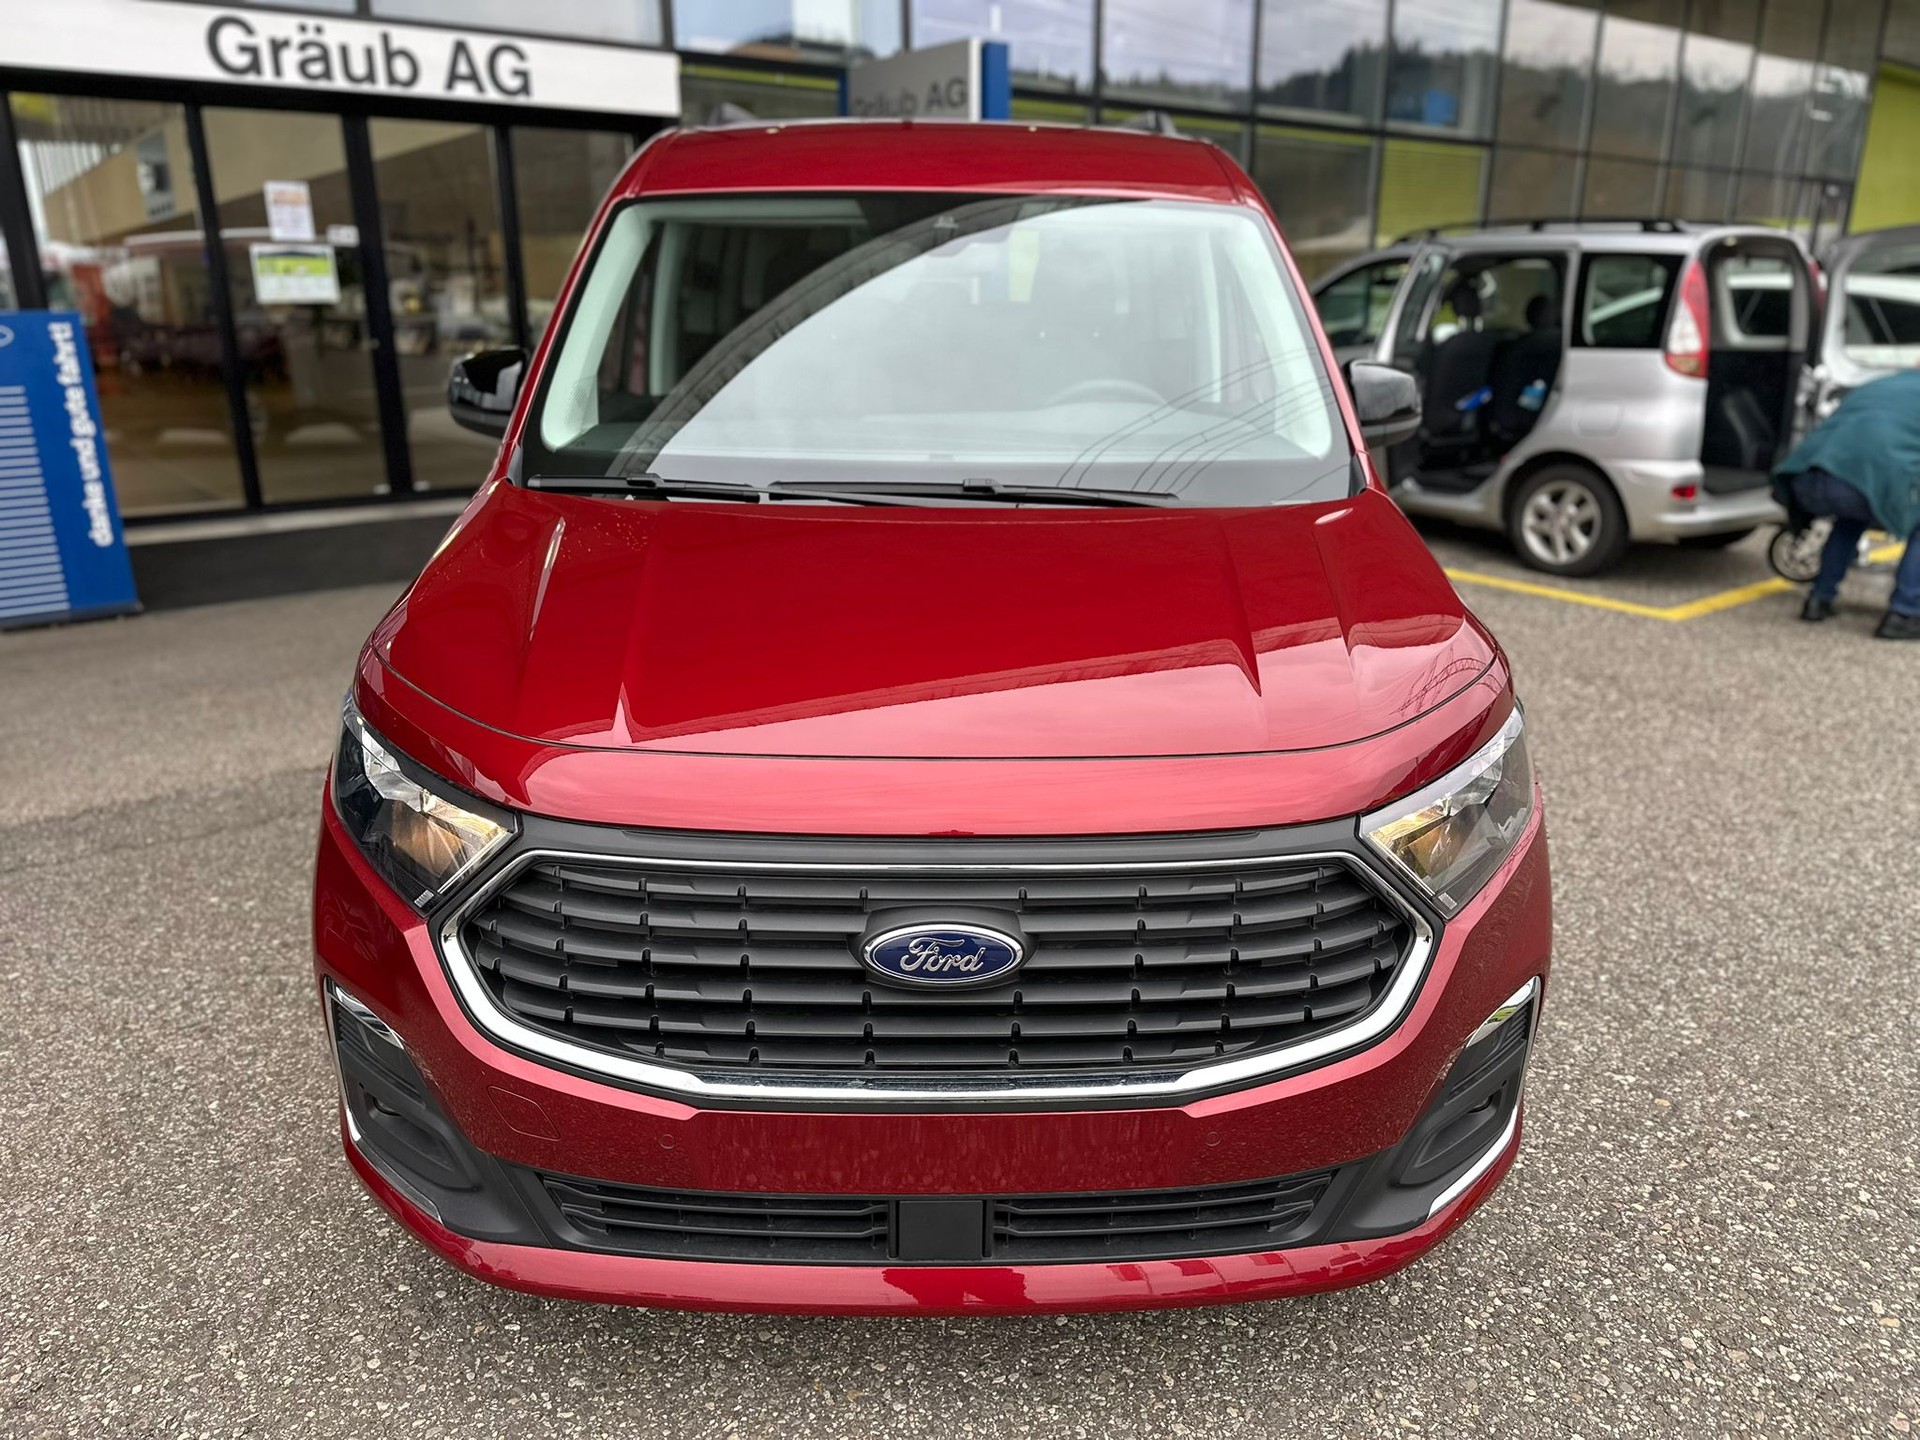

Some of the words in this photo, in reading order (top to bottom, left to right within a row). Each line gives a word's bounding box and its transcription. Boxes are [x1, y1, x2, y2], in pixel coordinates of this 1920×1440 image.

[205, 15, 421, 89] Gräub
[444, 38, 532, 98] AG
[925, 76, 968, 113] AG
[64, 385, 97, 437] gute
[69, 437, 102, 481] und
[82, 481, 115, 548] danke
[900, 937, 987, 972] Ford
